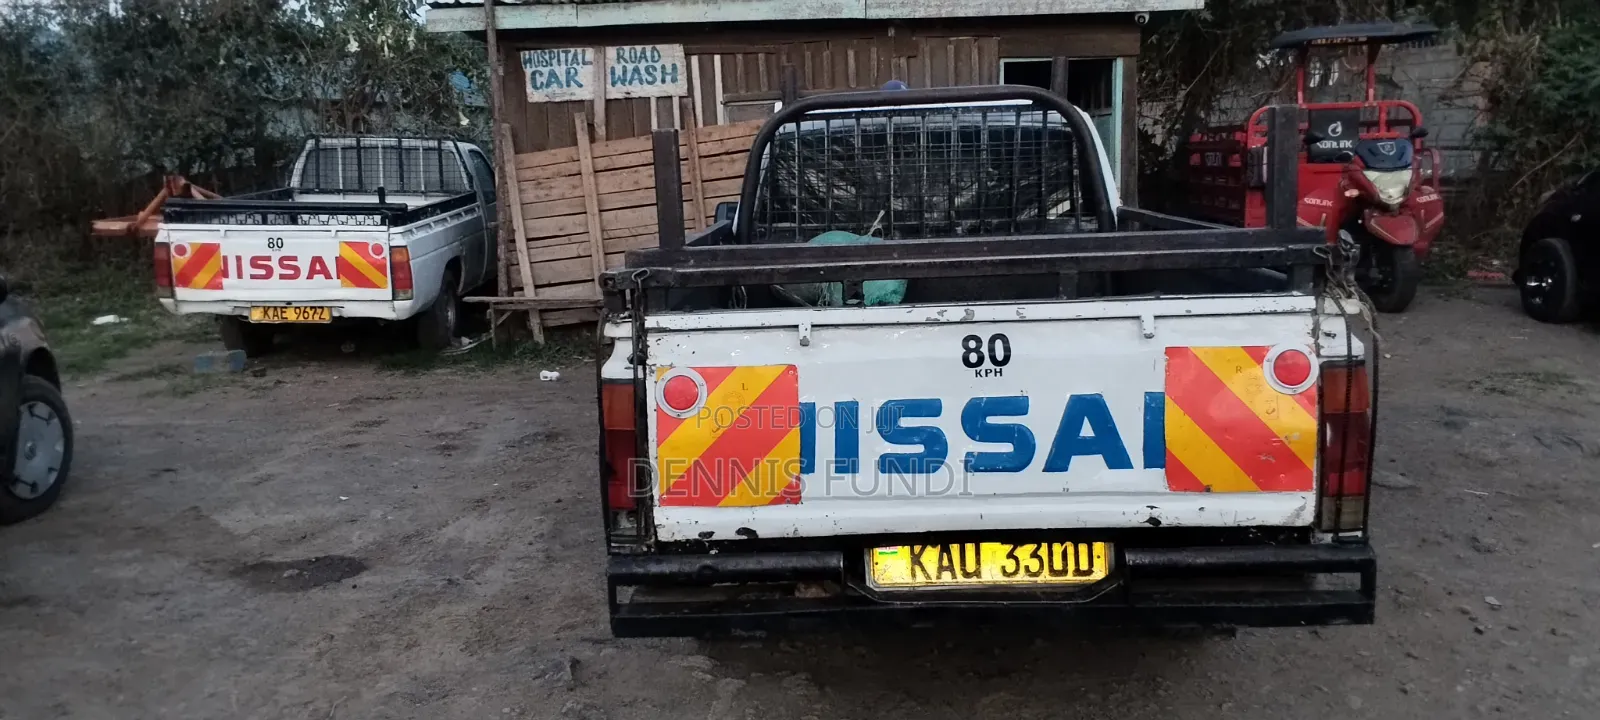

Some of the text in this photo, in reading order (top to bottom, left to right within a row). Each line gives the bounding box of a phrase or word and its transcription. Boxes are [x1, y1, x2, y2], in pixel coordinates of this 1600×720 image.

[522, 46, 661, 69] HOSPITAL ROAD
[531, 63, 678, 91] CAR WASH
[267, 237, 284, 249] 80
[222, 255, 340, 280] ISSA
[263, 306, 326, 320] KAE 967Z
[961, 333, 1011, 368] 80
[975, 368, 1003, 378] KPH
[910, 543, 982, 580] KAU
